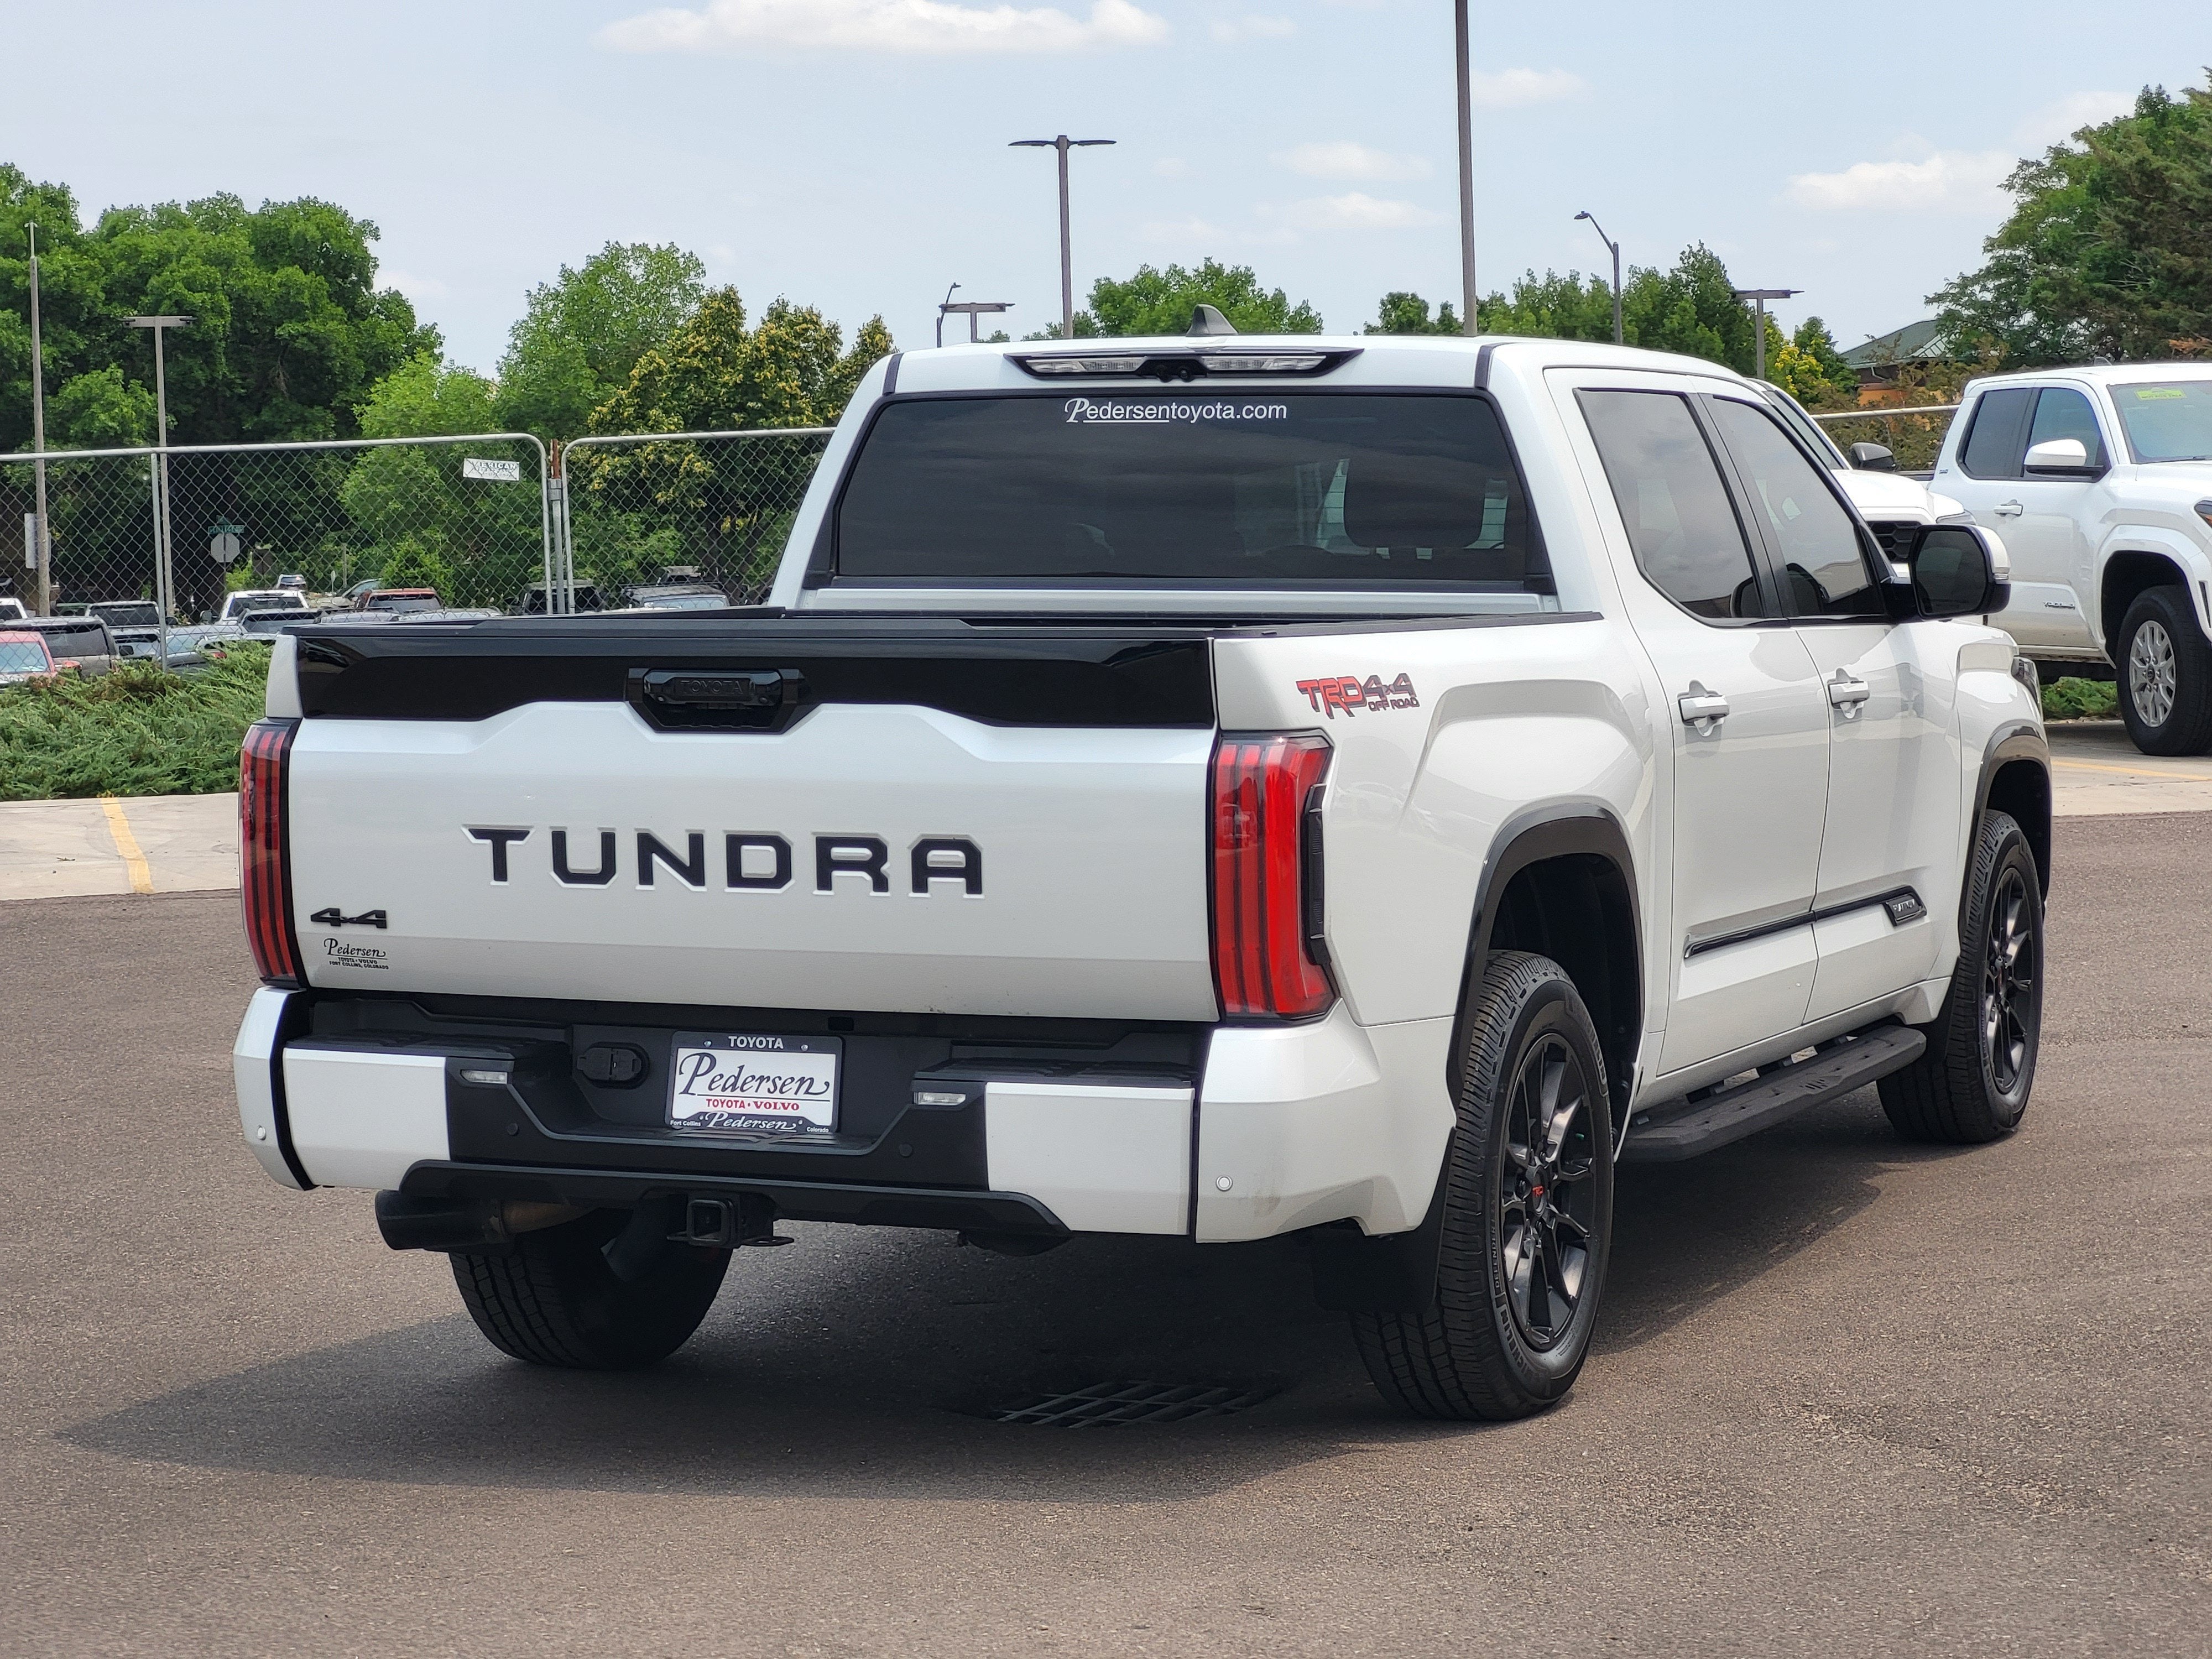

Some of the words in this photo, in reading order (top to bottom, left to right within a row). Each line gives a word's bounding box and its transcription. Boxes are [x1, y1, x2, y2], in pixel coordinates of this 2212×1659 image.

[1065, 398, 1287, 424] Pedersentoyota.com
[680, 680, 743, 694] TOYOTA
[1296, 676, 1366, 719] TRD
[1368, 701, 1389, 712] OFF
[1390, 697, 1420, 709] ROAD
[465, 826, 984, 896] TUNDRA
[324, 938, 387, 958] Pedersen
[728, 1036, 784, 1050] TOYOTA
[679, 1052, 830, 1096] Pedersen
[706, 1098, 745, 1109] TOYOTA
[753, 1101, 800, 1111] VOLVO
[705, 1110, 797, 1130] Pedersen
